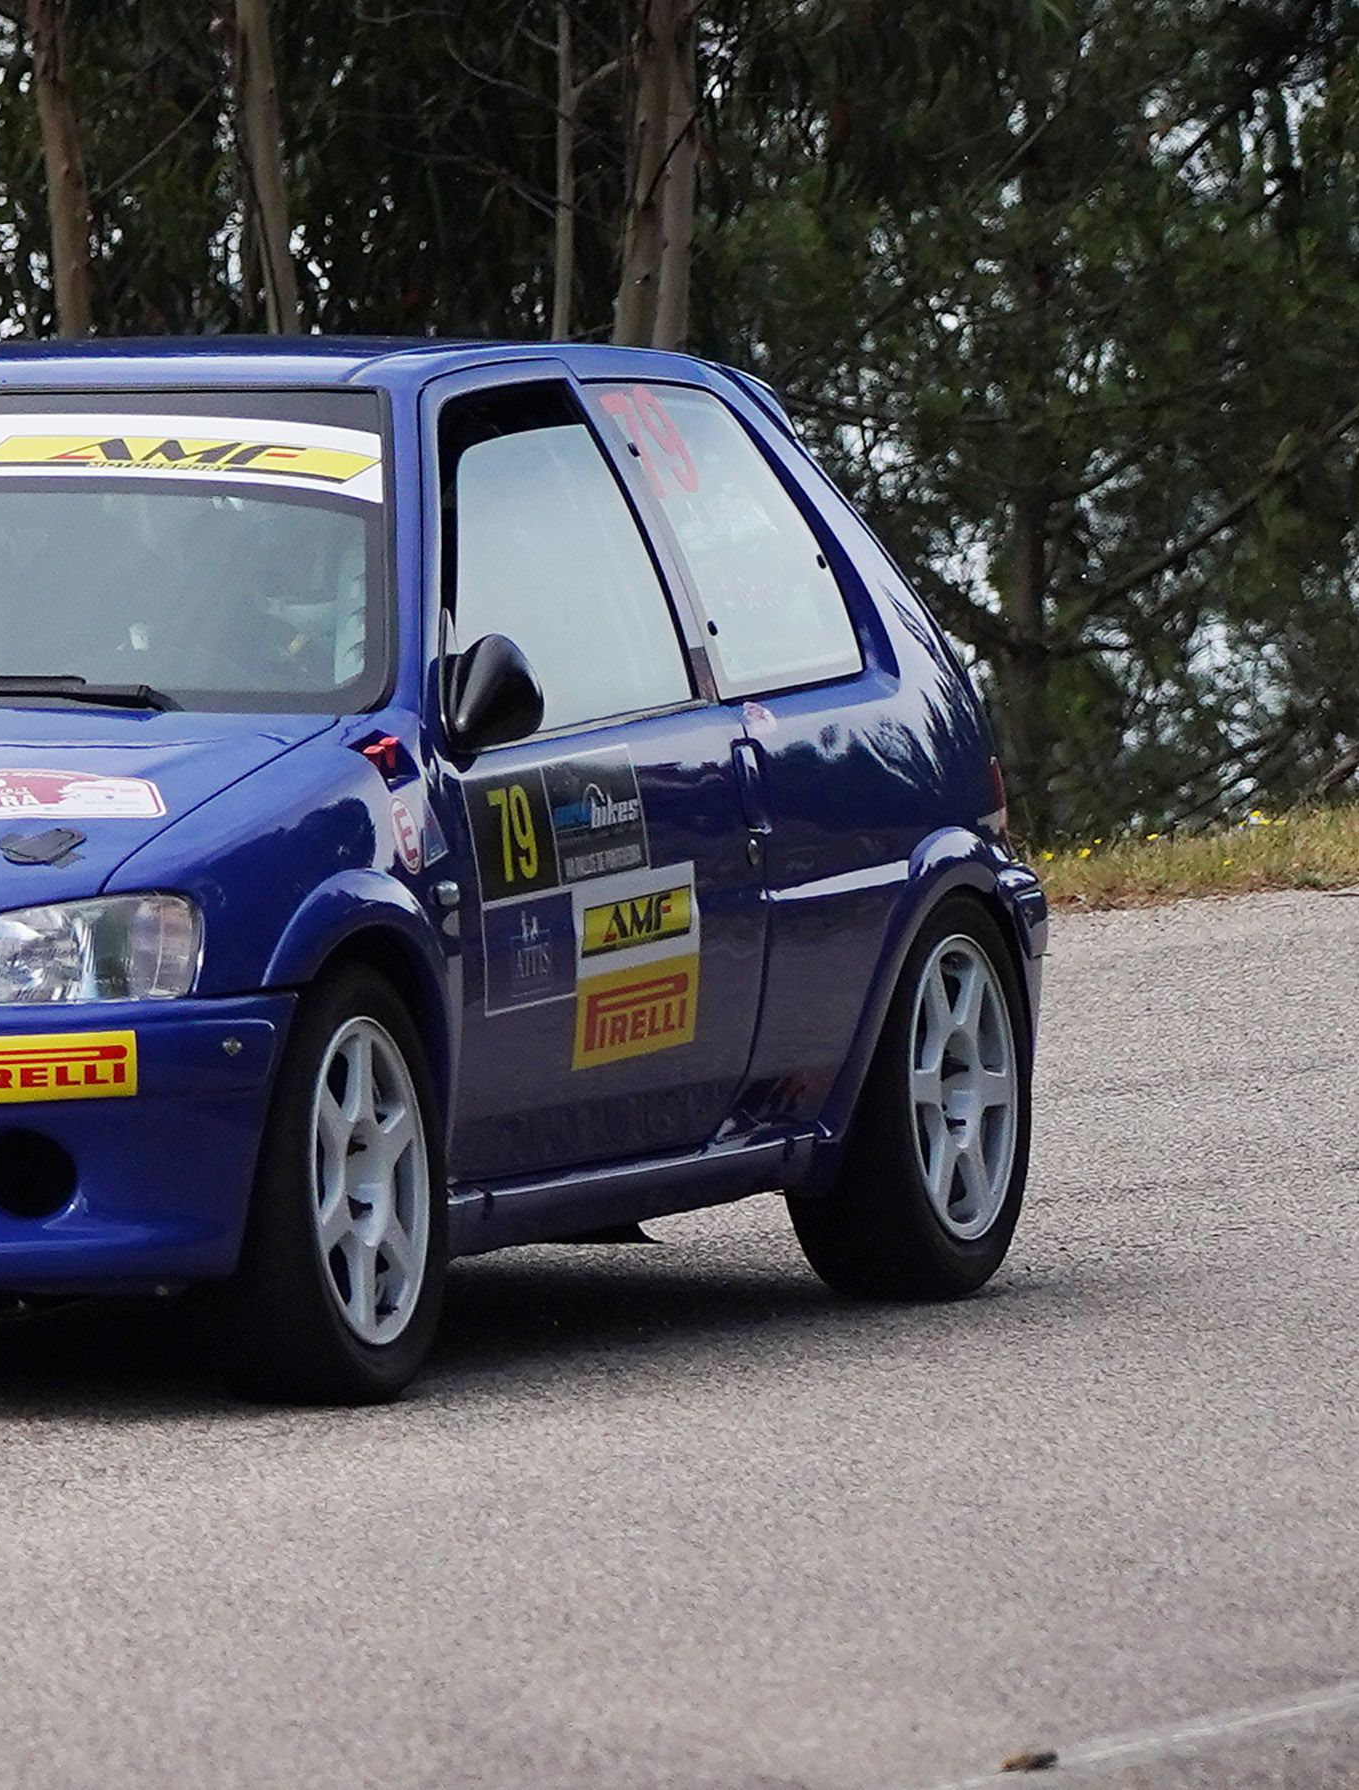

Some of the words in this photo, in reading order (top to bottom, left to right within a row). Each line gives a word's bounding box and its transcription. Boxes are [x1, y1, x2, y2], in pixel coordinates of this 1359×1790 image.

[46, 438, 307, 466] AMF
[87, 460, 234, 472] MOTORSPORT
[599, 385, 699, 499] 79
[486, 785, 538, 882] 79
[603, 893, 672, 942] AMF
[583, 972, 688, 1052] PIRELLI
